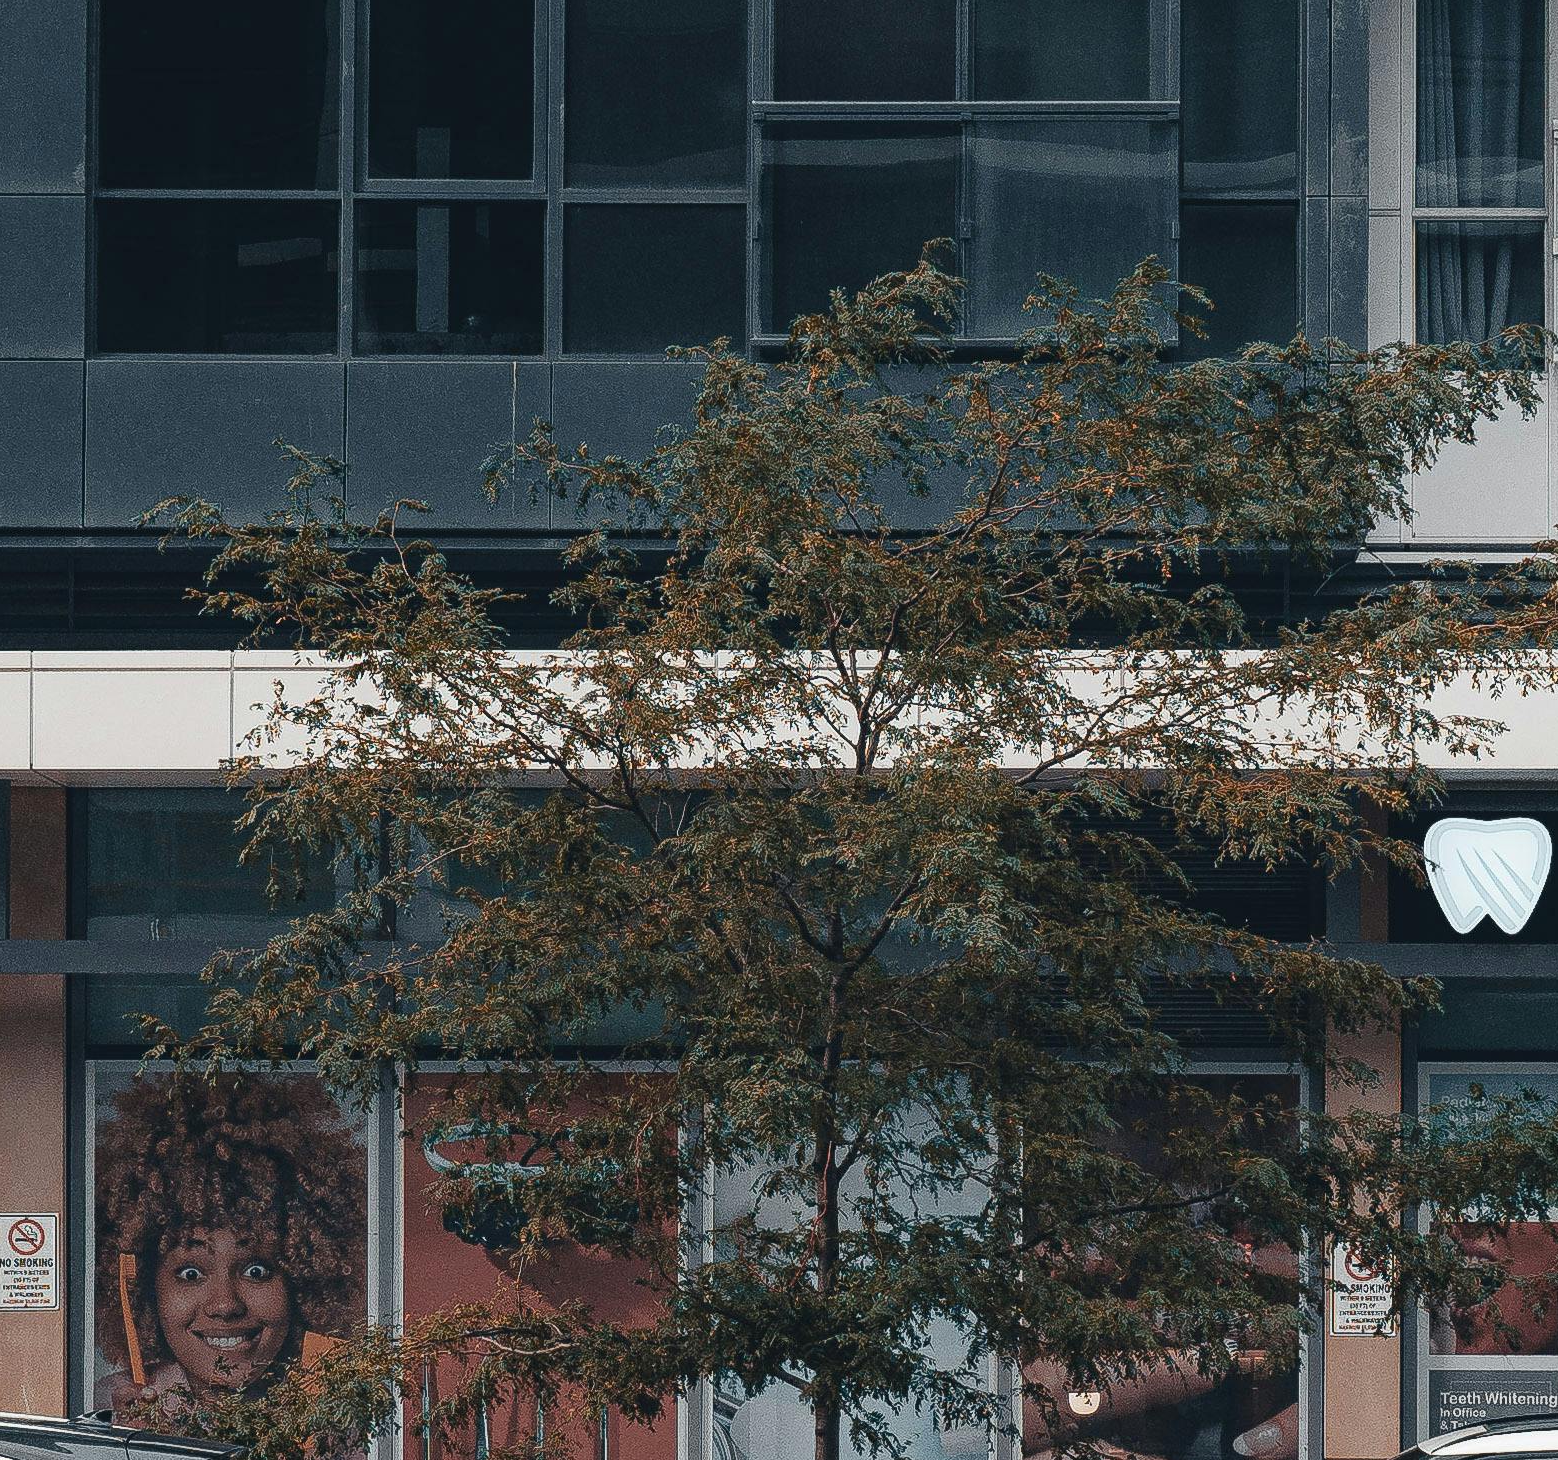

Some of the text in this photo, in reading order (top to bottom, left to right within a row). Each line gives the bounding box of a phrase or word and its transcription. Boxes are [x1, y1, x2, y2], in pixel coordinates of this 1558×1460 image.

[0, 1258, 54, 1268] NO SMOKING
[1441, 1392, 1558, 1408] Teeth Whitening
[1440, 1407, 1487, 1417] In Office
